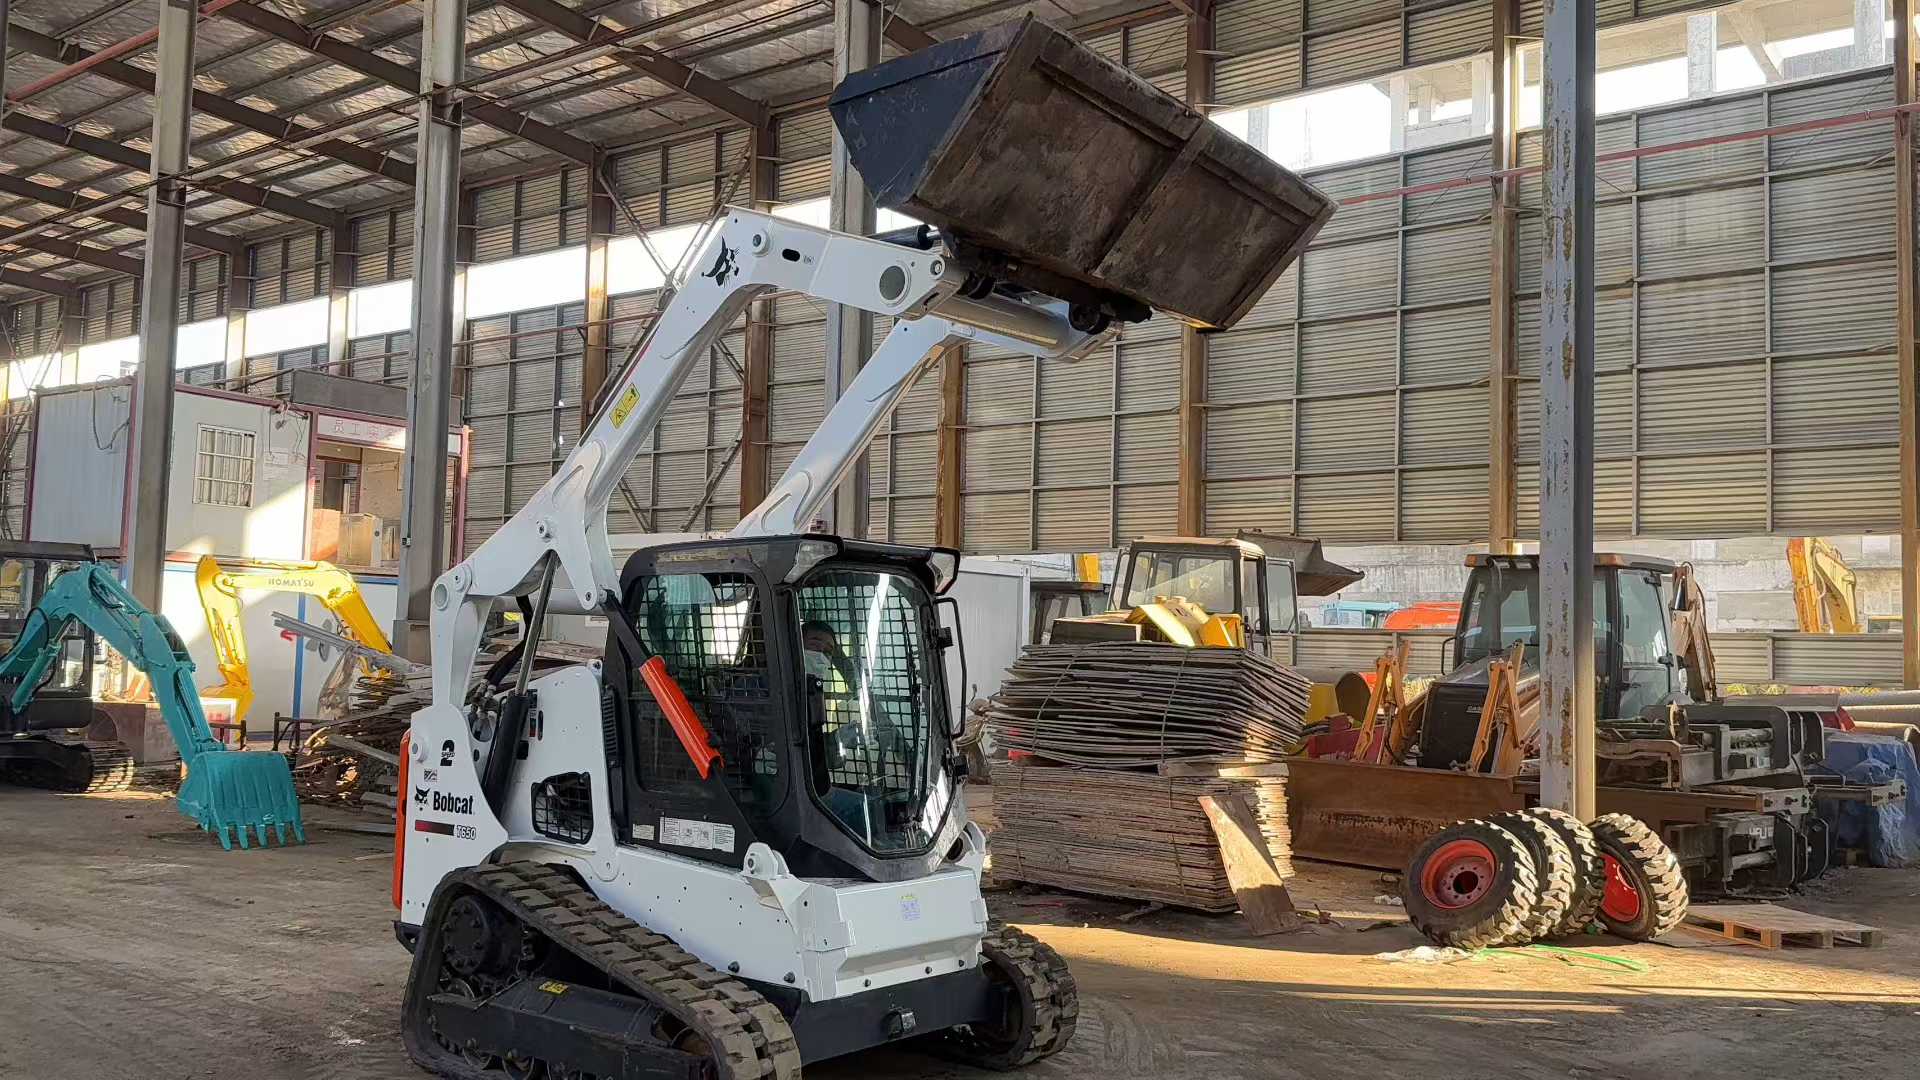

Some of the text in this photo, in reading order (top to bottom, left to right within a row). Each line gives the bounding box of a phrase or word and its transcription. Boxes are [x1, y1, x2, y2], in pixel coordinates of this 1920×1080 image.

[268, 578, 314, 587] KOMATSU
[440, 740, 455, 766] 2
[433, 791, 473, 814] Bobcat
[456, 825, 477, 840] T650
